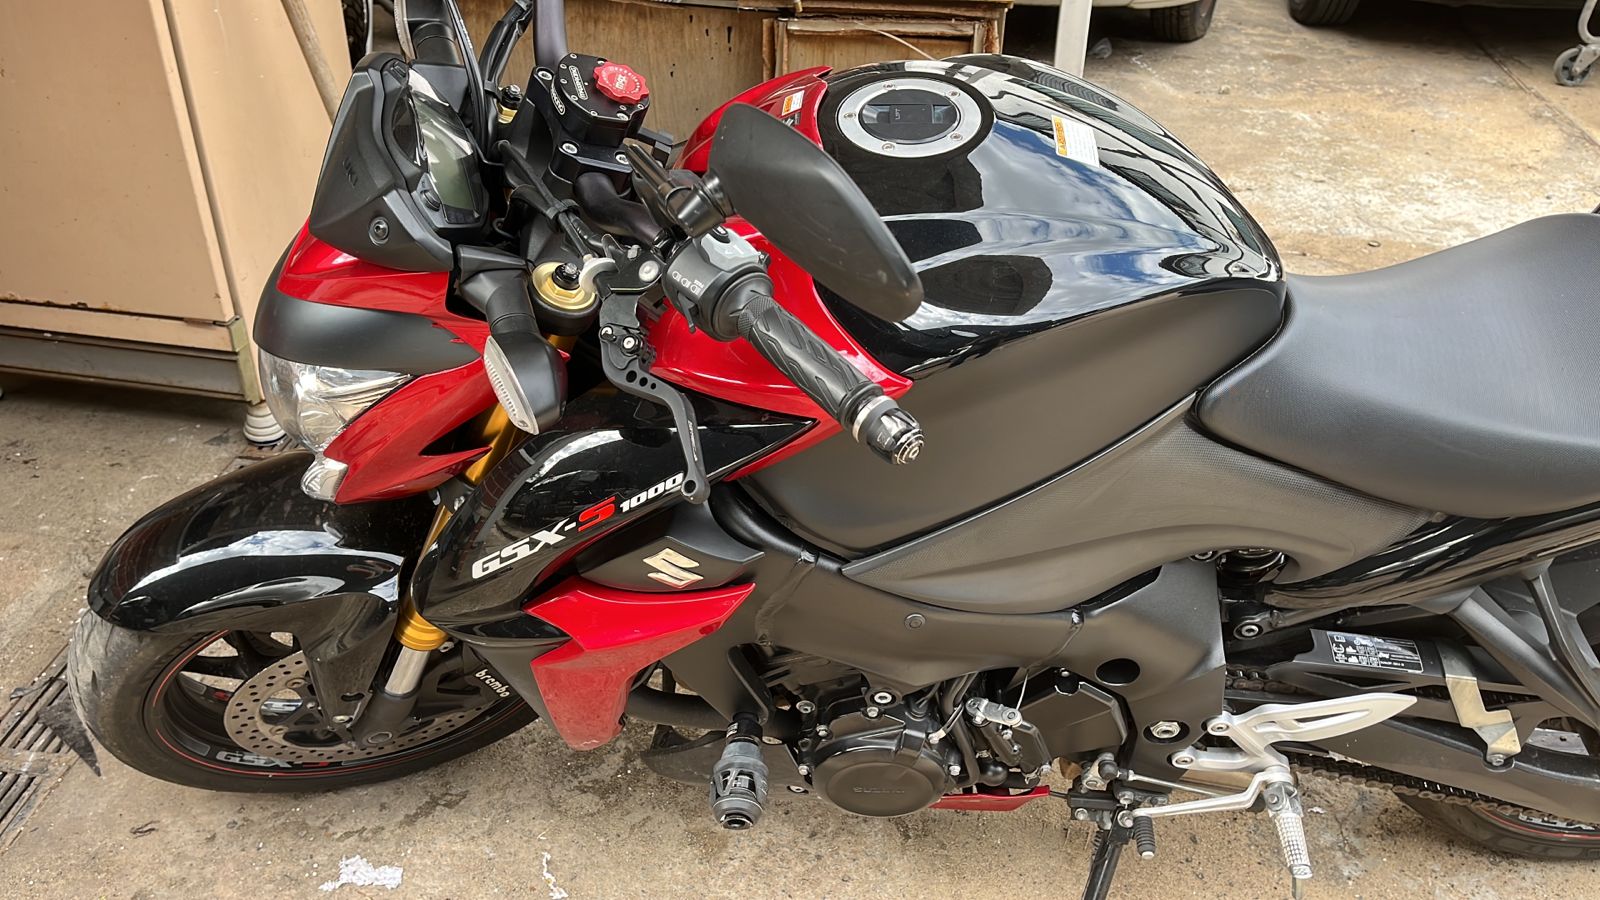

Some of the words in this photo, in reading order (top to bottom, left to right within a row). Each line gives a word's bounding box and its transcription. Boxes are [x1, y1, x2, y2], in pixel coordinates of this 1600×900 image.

[471, 496, 617, 580] GSX-S
[619, 472, 684, 513] 1000
[475, 668, 510, 698] brembo
